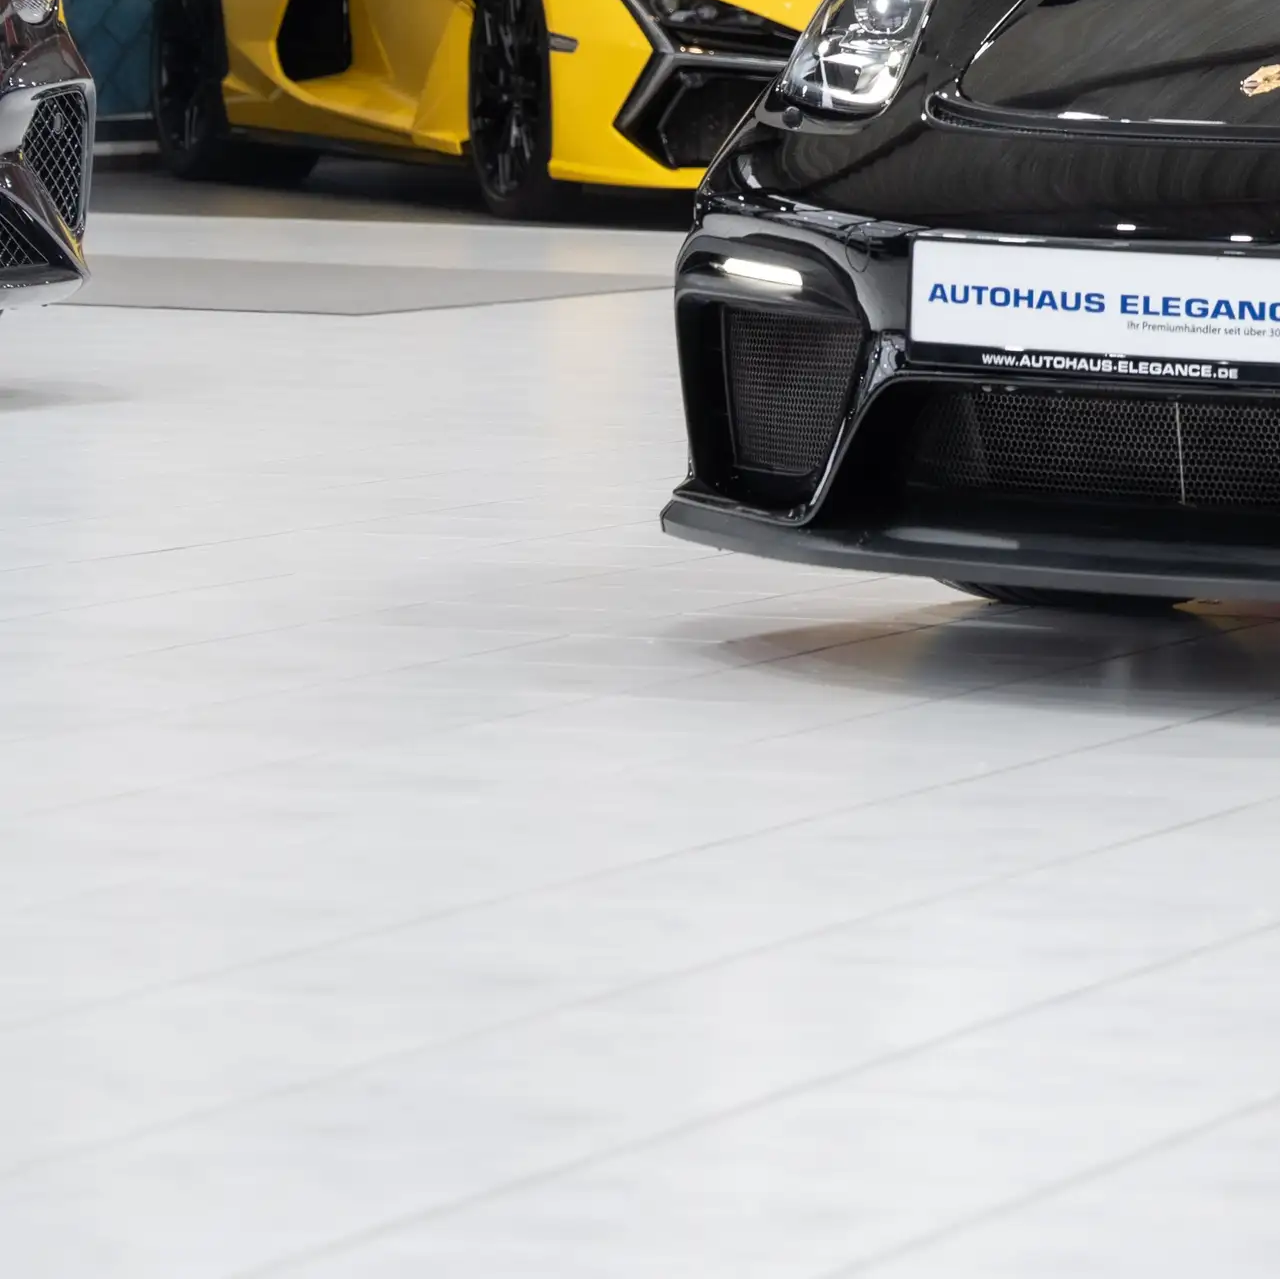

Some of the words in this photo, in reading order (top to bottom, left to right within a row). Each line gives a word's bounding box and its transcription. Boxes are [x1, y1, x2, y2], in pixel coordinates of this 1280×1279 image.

[928, 283, 1105, 313] AUTOHAUS
[1127, 320, 1140, 331] Ihr
[1142, 322, 1221, 335] Premiumhändler
[1224, 327, 1241, 337] seit
[1243, 327, 1266, 338] über
[1269, 328, 1280, 338] 30
